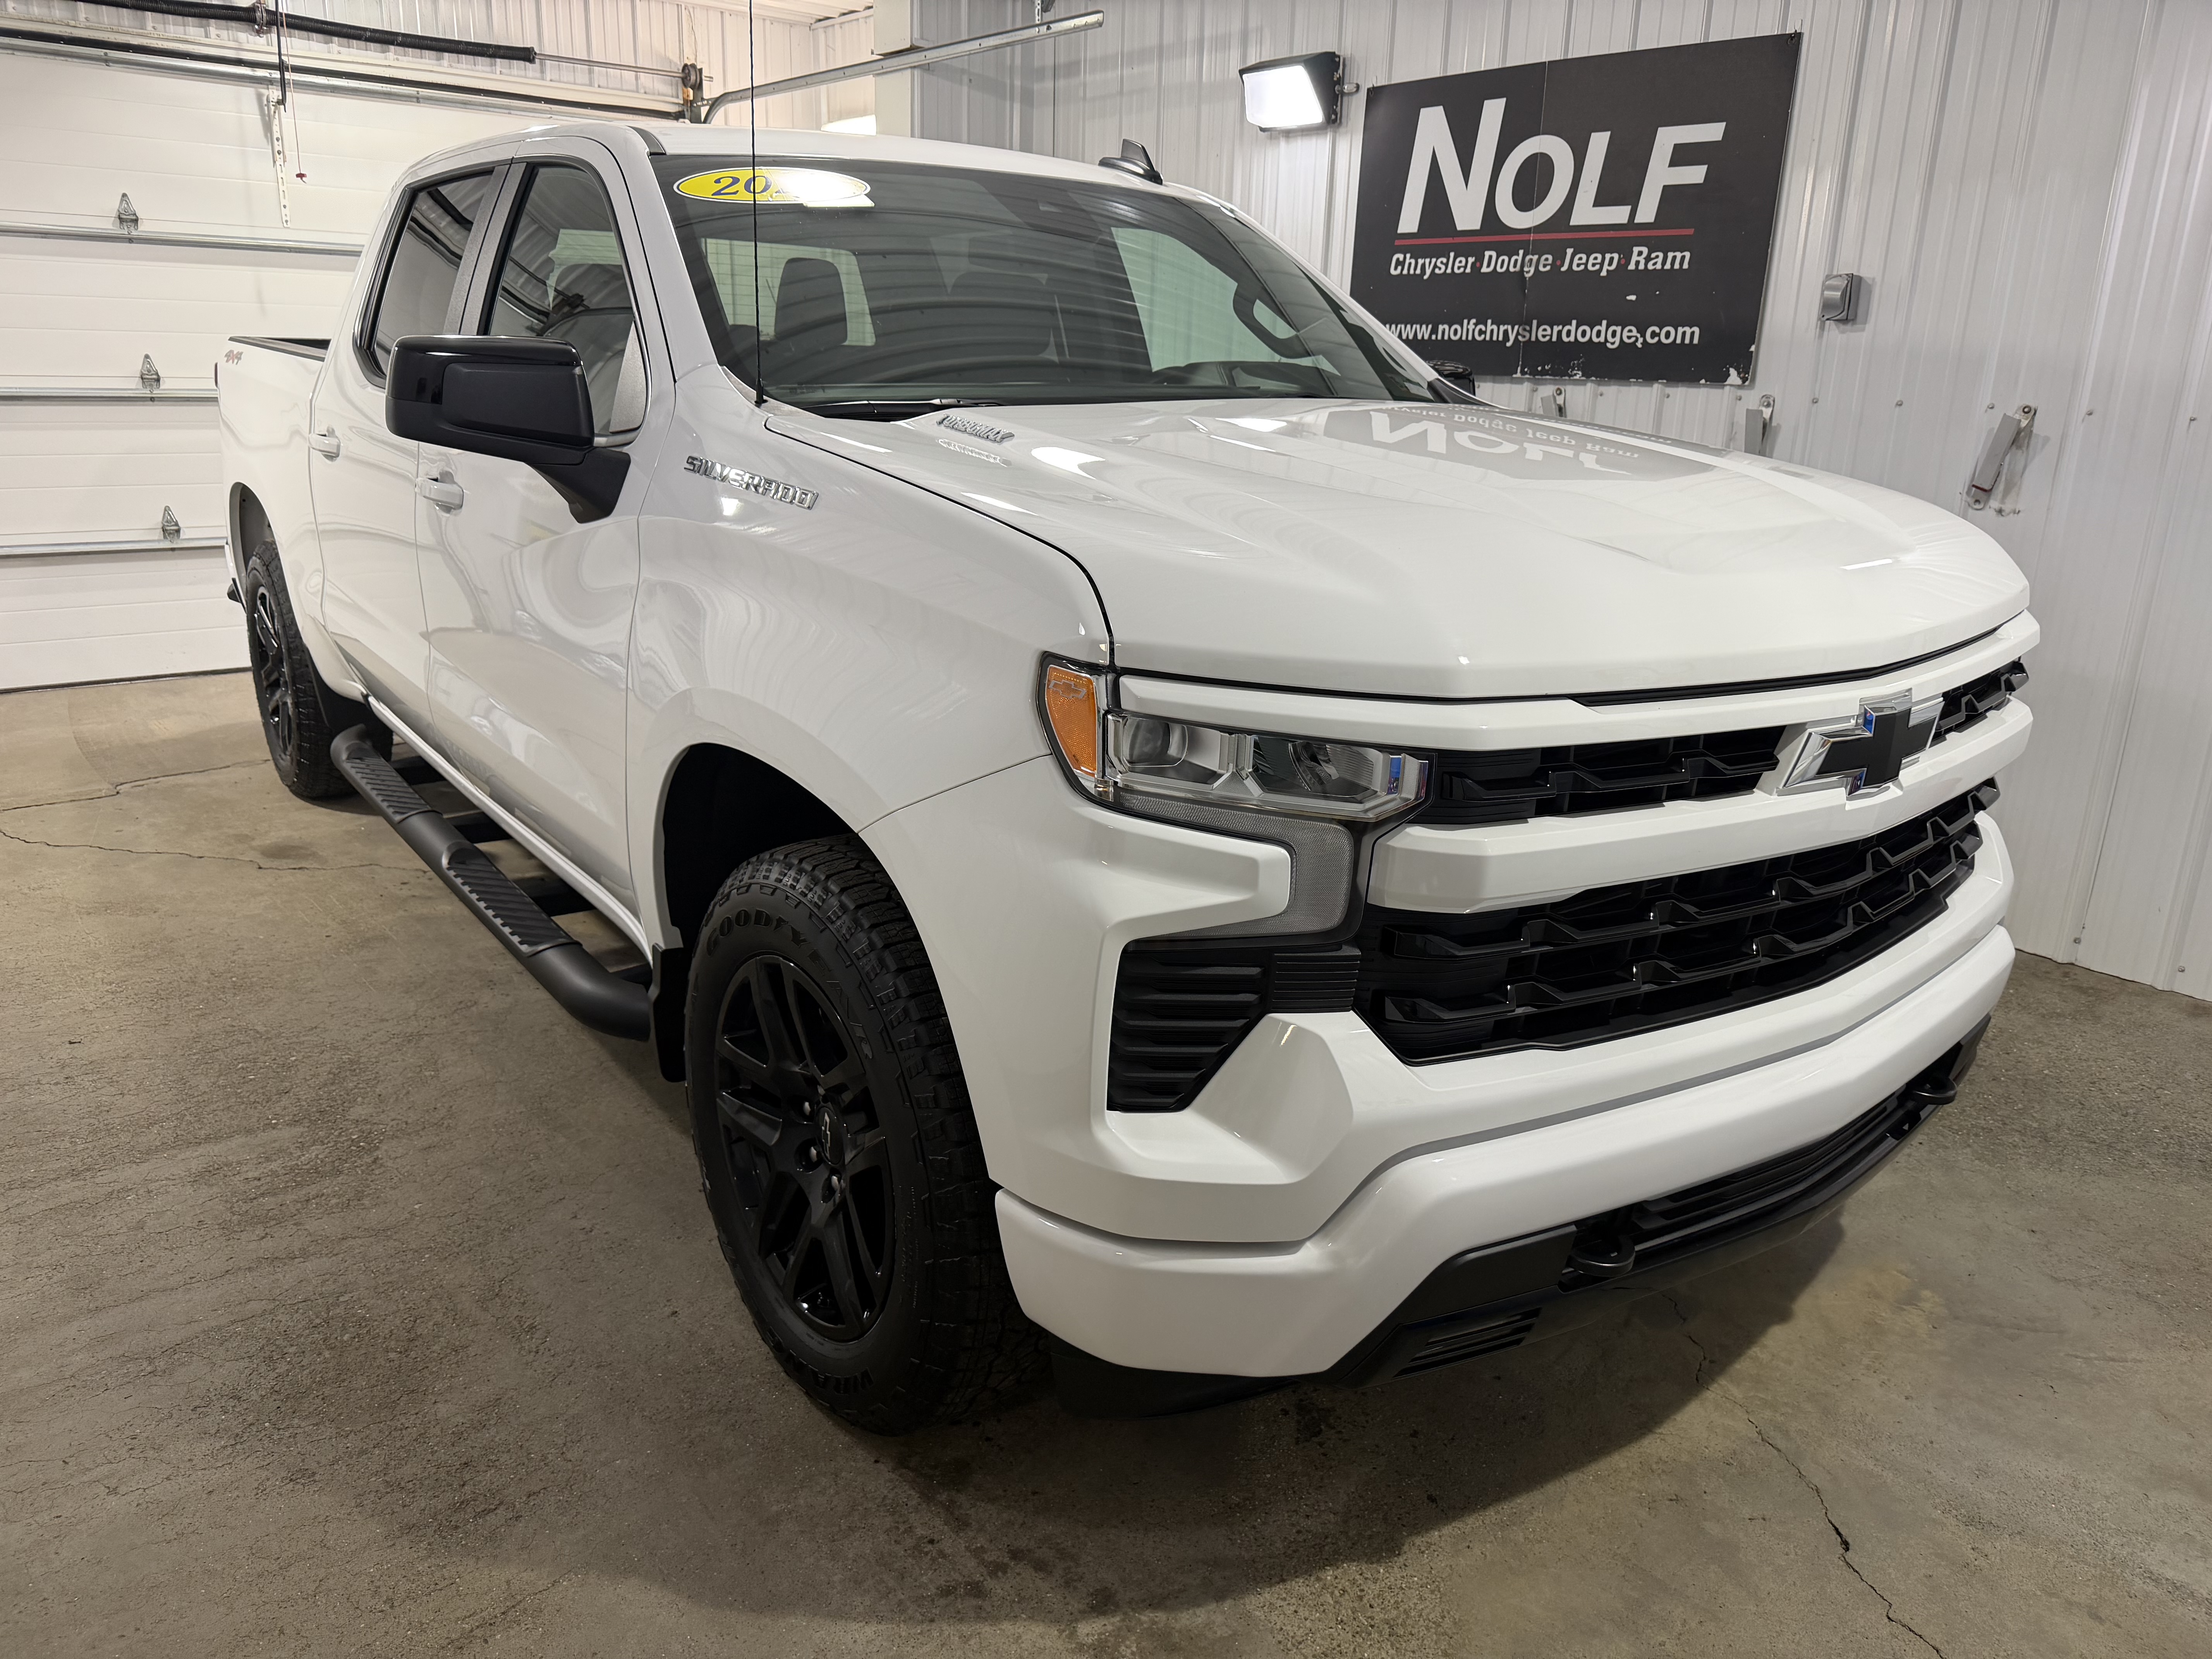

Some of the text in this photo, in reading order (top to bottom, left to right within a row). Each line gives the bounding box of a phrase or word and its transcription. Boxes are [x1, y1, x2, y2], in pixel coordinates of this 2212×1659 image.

[1397, 97, 1726, 234] NOLF
[1389, 246, 1691, 280] Chrysler Dodge Jeep Ram
[1385, 318, 1700, 347] www.nolfchryslerdodge.com
[684, 455, 819, 510] SILVERADO
